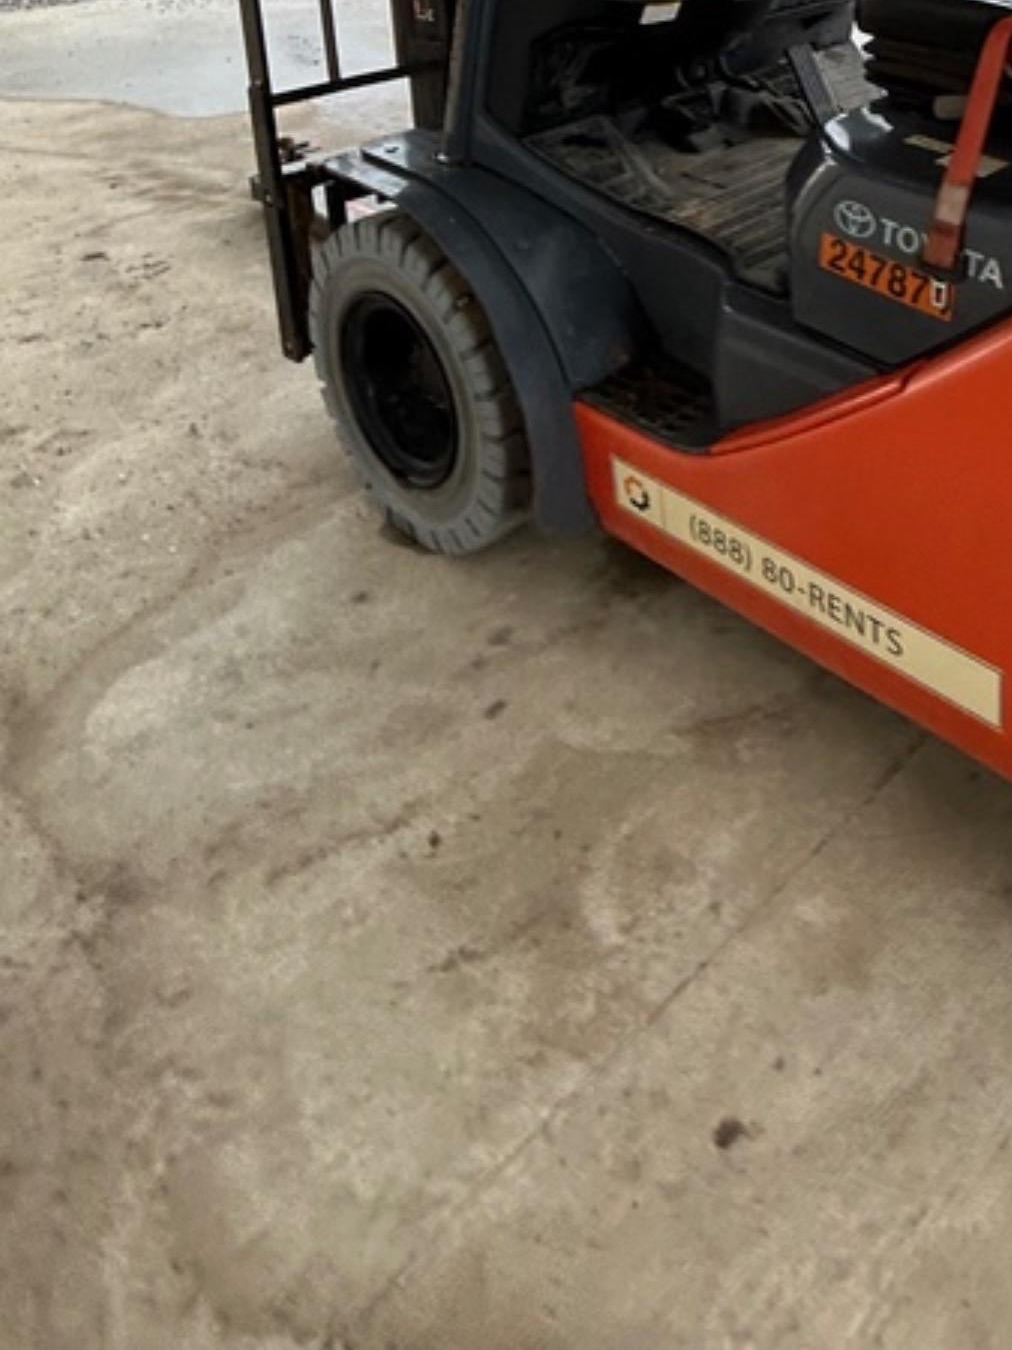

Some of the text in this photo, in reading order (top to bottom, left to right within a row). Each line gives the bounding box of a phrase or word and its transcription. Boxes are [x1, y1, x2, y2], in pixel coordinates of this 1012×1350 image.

[828, 238, 953, 317] 24787
[879, 217, 1004, 291] TOTA
[689, 513, 904, 657] (888) 80-RENTS
